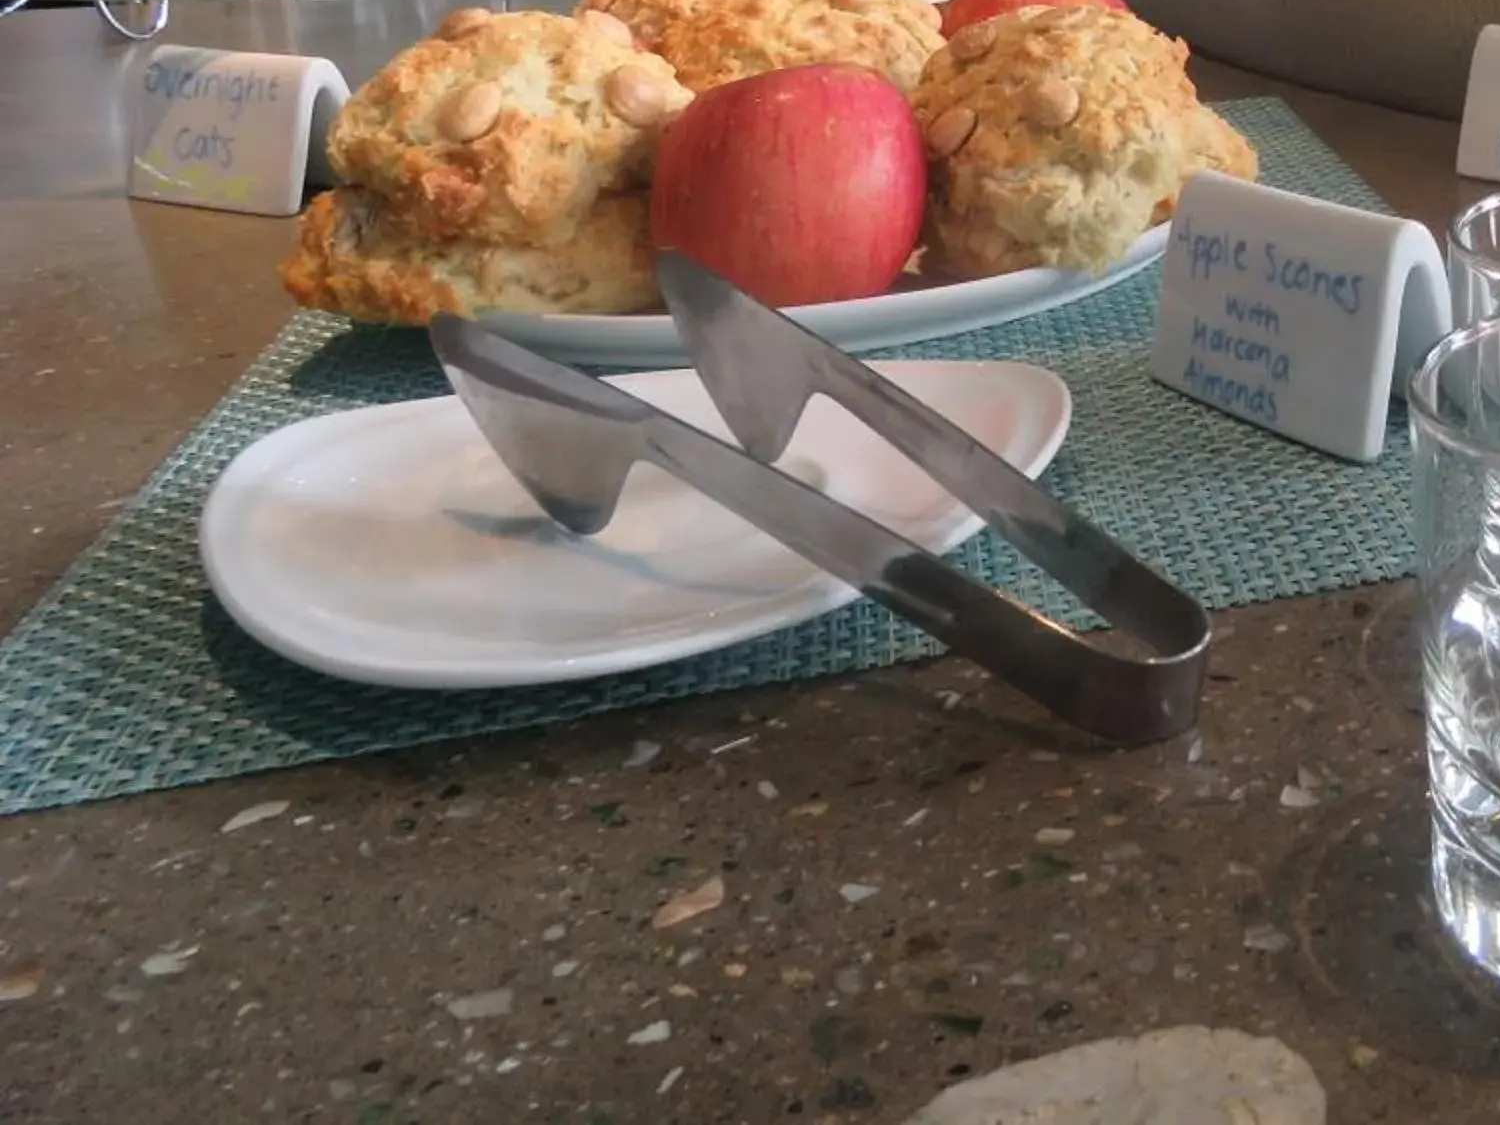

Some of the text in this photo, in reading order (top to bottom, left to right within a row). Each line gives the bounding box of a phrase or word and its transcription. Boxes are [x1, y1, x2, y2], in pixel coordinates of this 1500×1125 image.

[1177, 214, 1365, 315] Apple Scones
[1225, 293, 1280, 336] with
